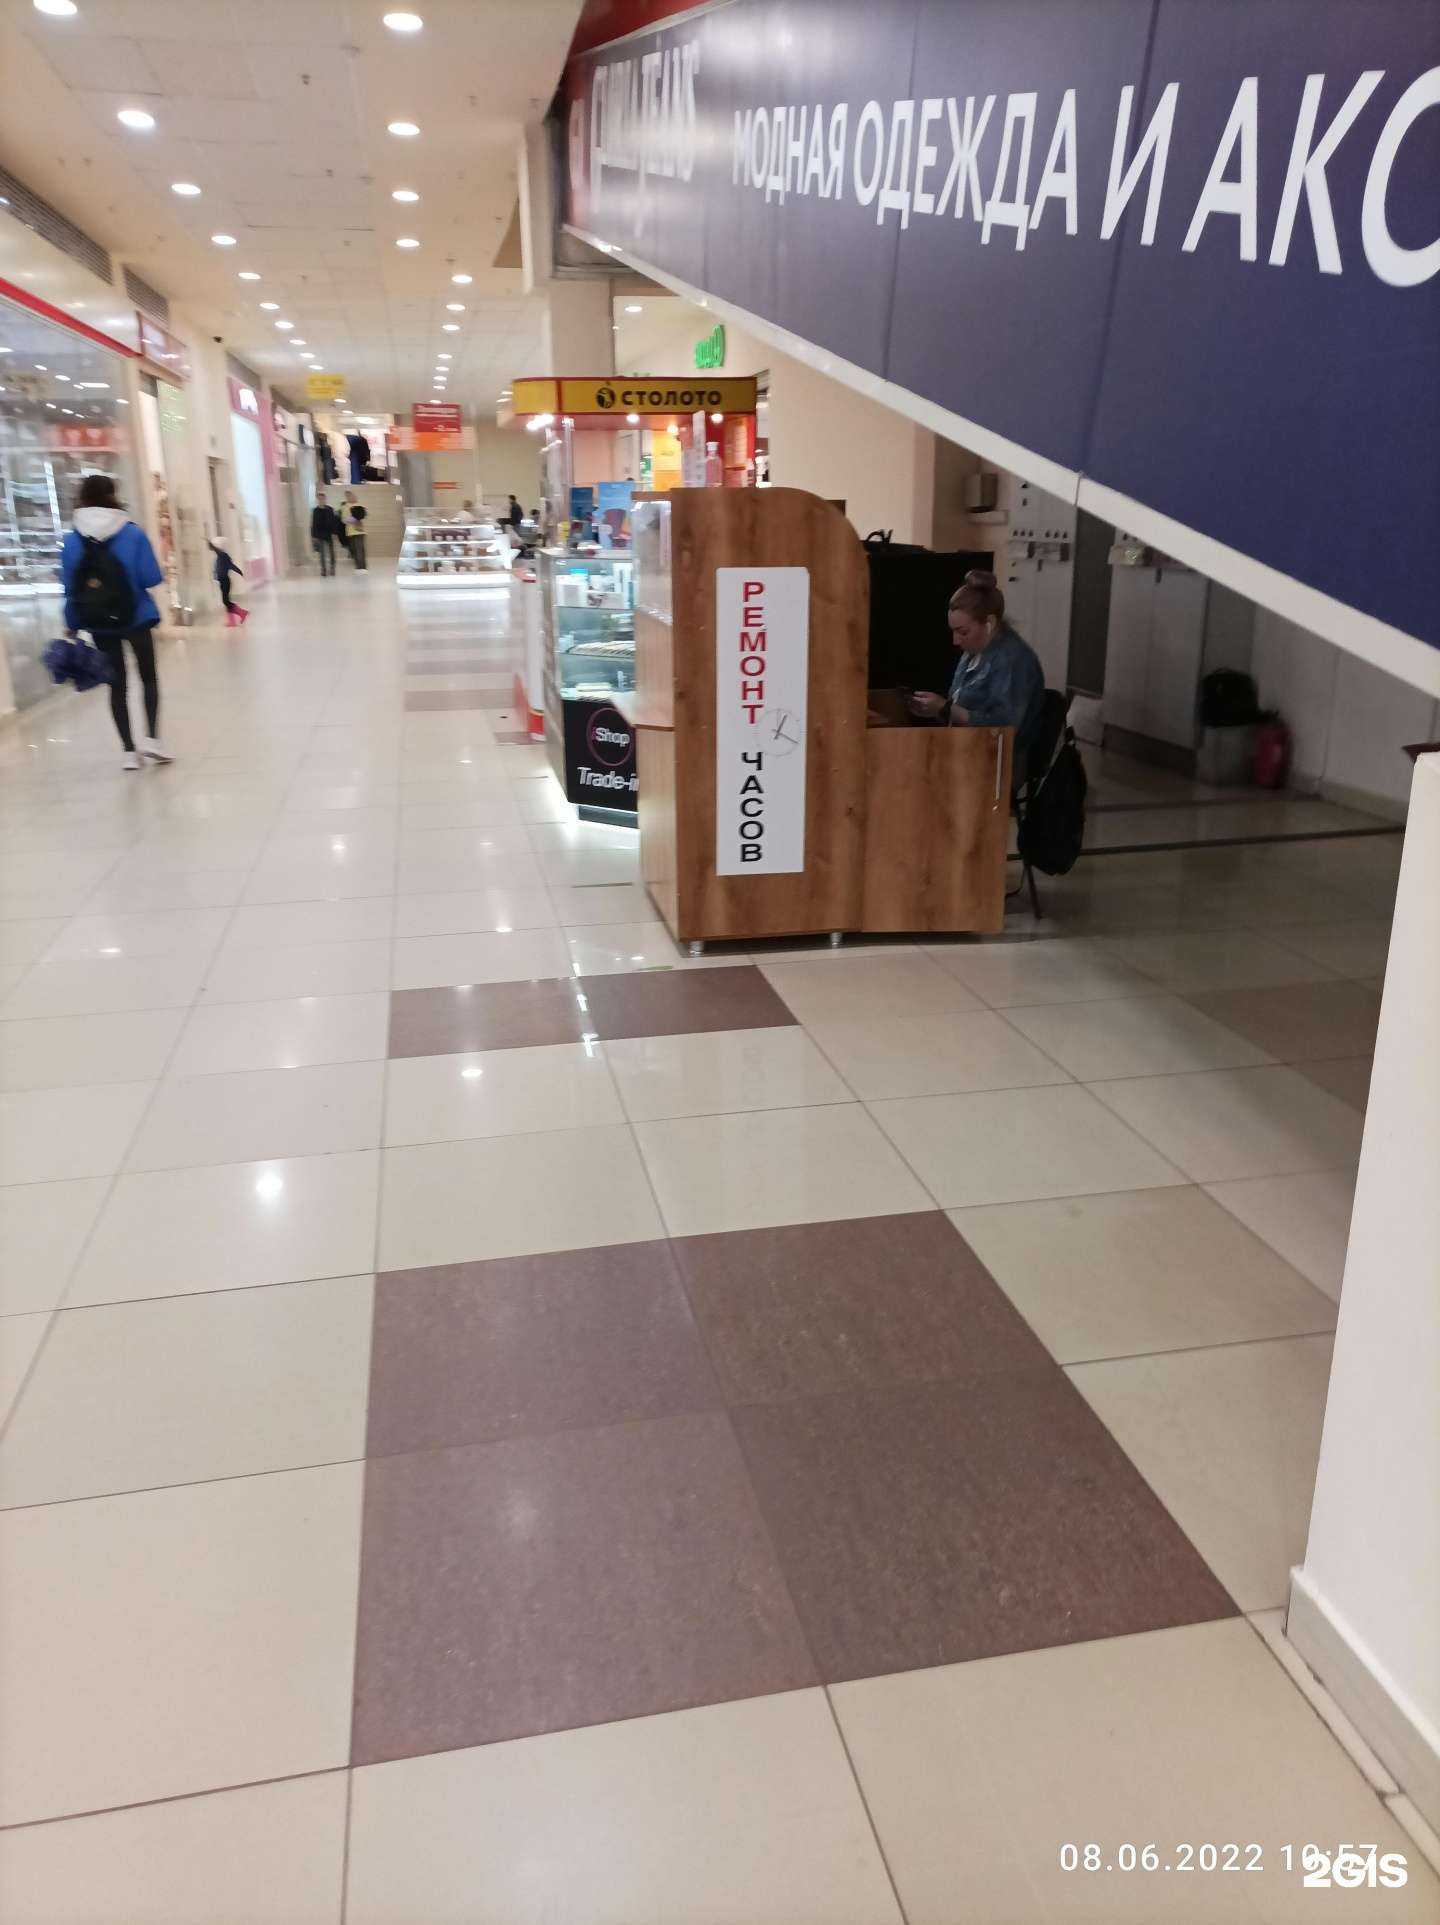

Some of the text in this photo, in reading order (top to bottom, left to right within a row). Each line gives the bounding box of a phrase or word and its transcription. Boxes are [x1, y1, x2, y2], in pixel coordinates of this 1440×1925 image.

[732, 103, 848, 206] МОДНАЯ
[854, 88, 1078, 251] ОДЕЖДА
[1100, 82, 1180, 246] И
[621, 390, 722, 406] СТОЛОТО
[739, 581, 767, 863] РЕМОНТ ЧАСОВ
